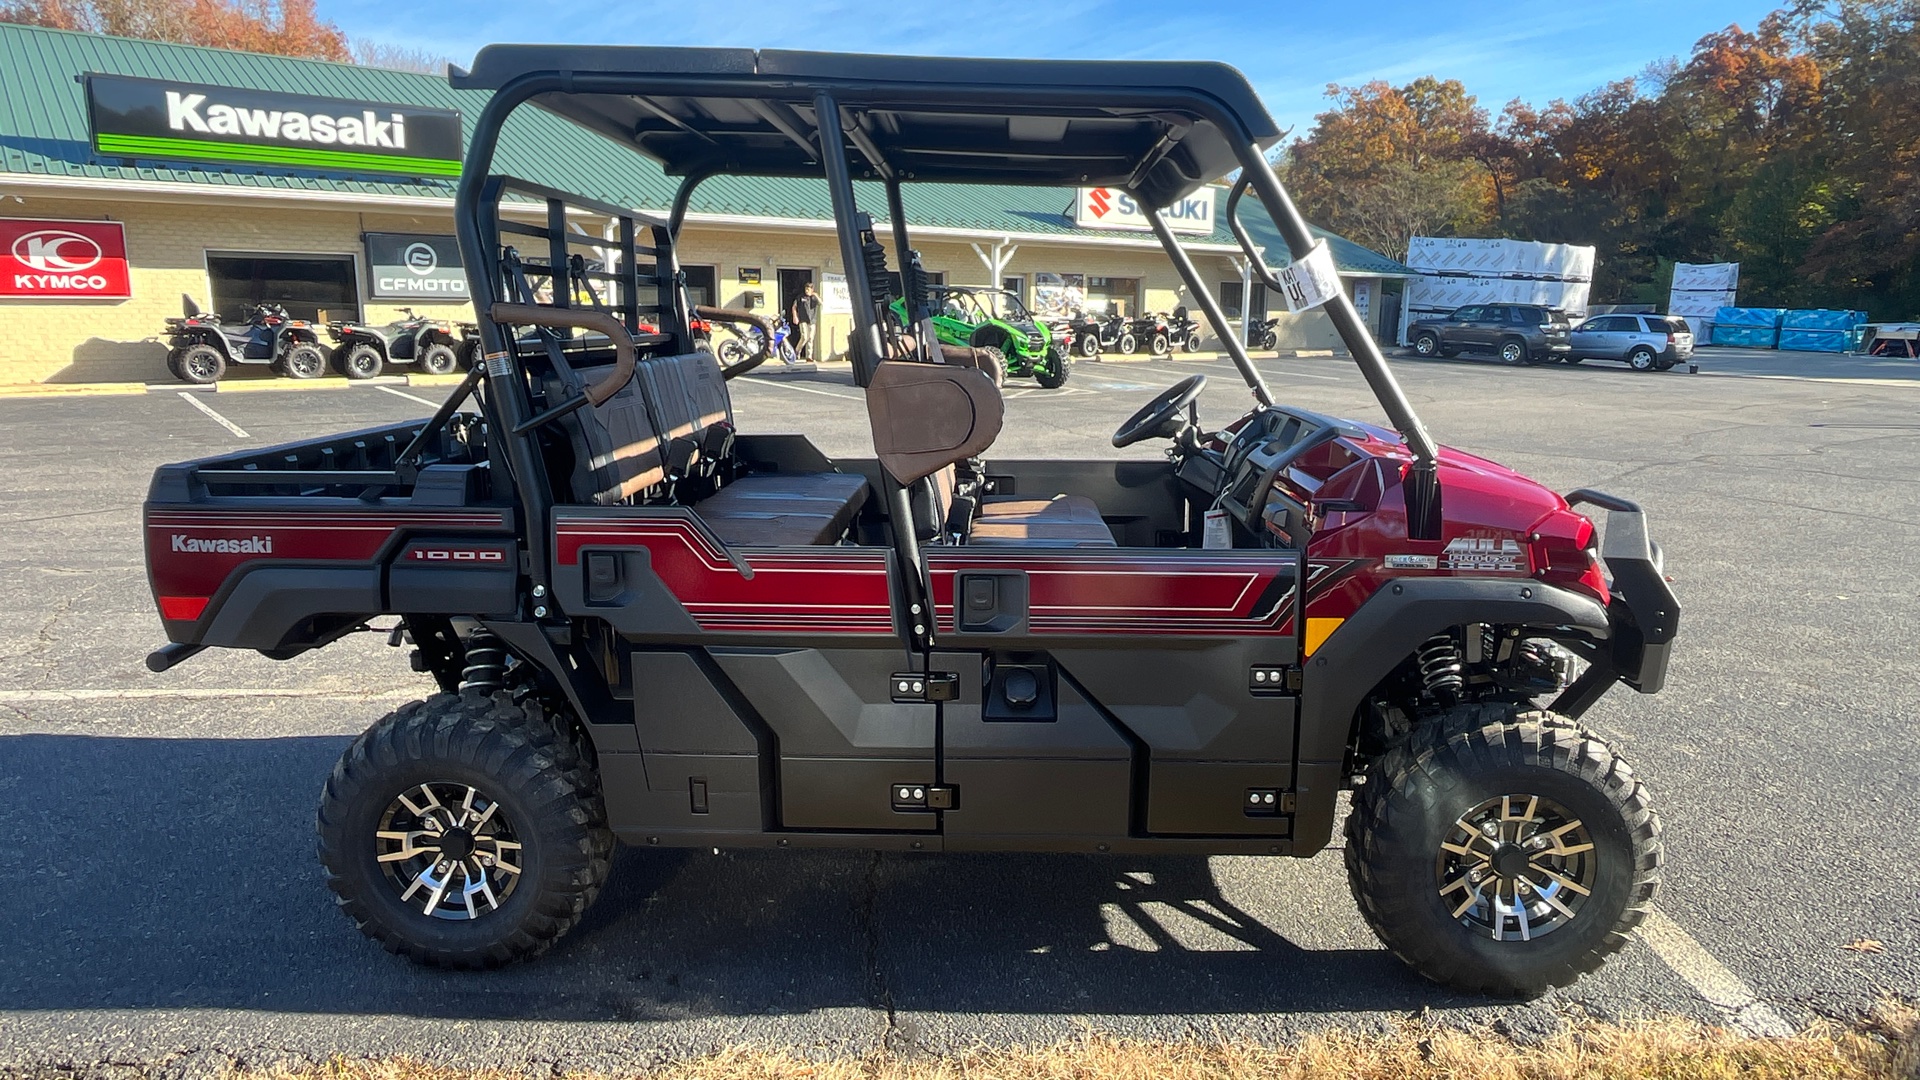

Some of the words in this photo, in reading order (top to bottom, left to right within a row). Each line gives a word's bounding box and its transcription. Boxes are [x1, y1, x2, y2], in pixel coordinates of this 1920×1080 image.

[165, 91, 406, 149] Kawasaki
[1118, 193, 1208, 221] SUKI
[14, 274, 107, 290] KYMCO
[379, 277, 465, 292] CFMOTO
[171, 534, 273, 554] Kawasaki
[1441, 537, 1523, 555] MULE
[414, 550, 502, 560] 1000
